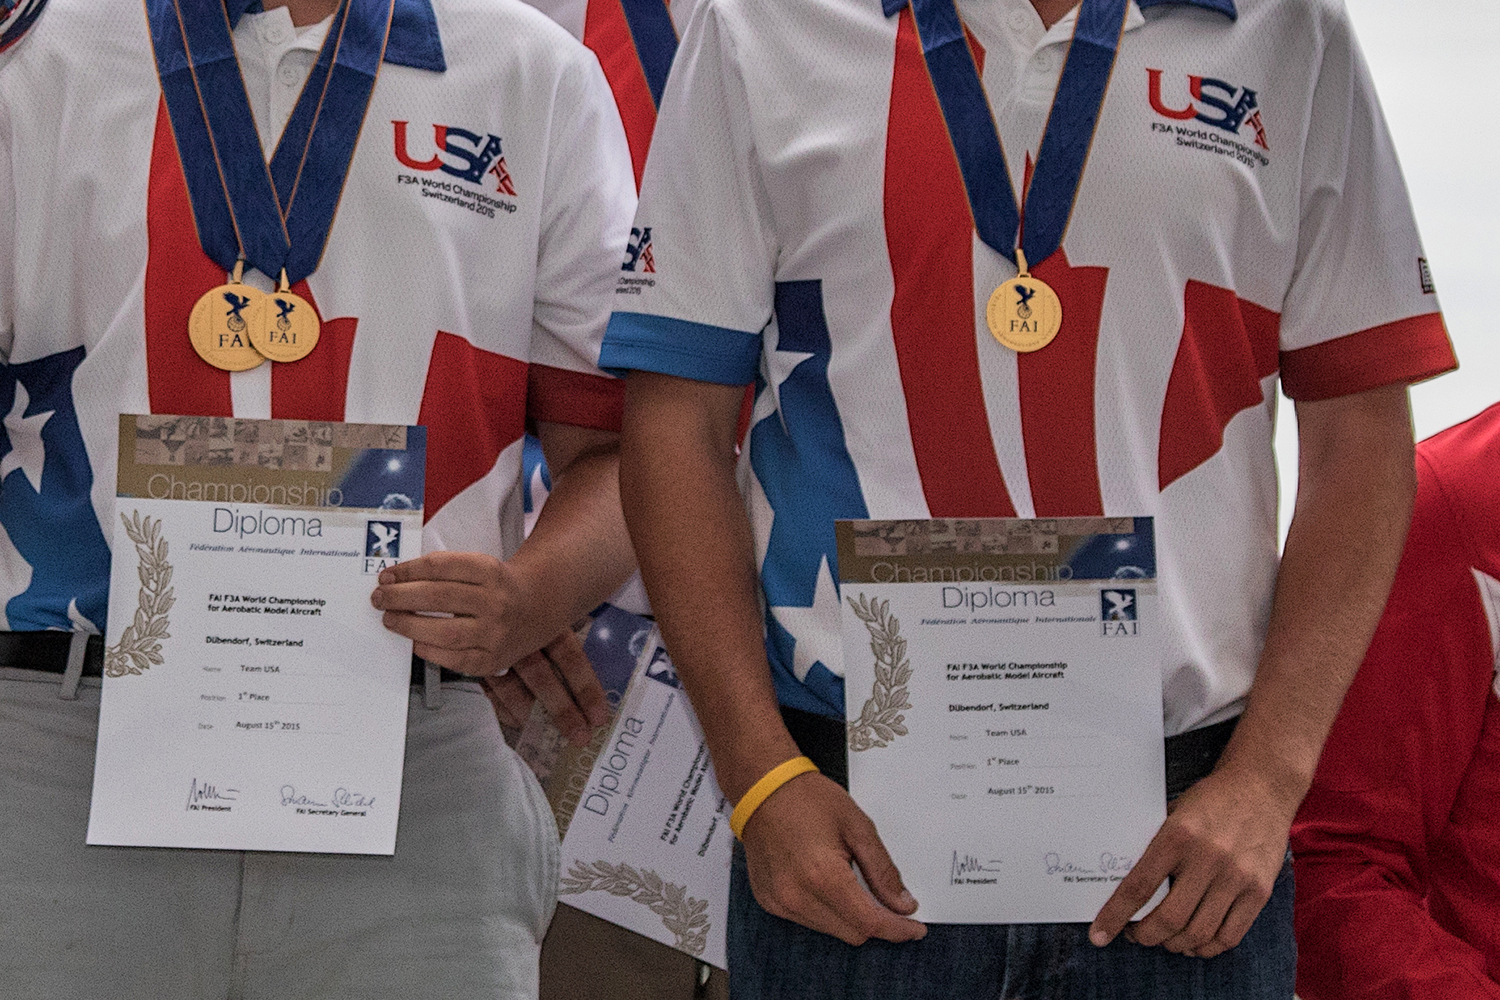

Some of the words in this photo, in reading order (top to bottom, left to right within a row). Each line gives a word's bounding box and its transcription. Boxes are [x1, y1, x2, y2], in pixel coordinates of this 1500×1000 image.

[1146, 68, 1270, 151] USA
[1152, 123, 1173, 133] F3A
[1176, 126, 1207, 139] World
[1209, 133, 1269, 166] Championship
[391, 121, 518, 197] USA
[1177, 137, 1235, 158] Switzerland
[1236, 151, 1254, 168] 2015
[398, 175, 419, 185] F3A
[422, 178, 451, 192] World
[453, 185, 517, 214] Championship
[422, 189, 475, 211] Switzerland
[476, 202, 495, 218] 2015
[1010, 320, 1037, 332] FAI
[270, 331, 296, 344] FAI
[147, 474, 344, 508] Championship
[213, 508, 322, 539] Diploma
[871, 561, 1074, 584] Championship
[209, 594, 222, 602] FAI
[224, 595, 240, 603] F3A
[268, 597, 326, 606] Championship
[942, 586, 1056, 612] Diploma
[208, 604, 220, 612] for
[222, 605, 261, 614] Aerobatic
[291, 608, 321, 616] Aircraft
[1103, 622, 1138, 635] FAI
[206, 636, 252, 646] Dübendorf,
[255, 638, 303, 647] Switzerland
[947, 663, 960, 671] FAI
[981, 662, 1006, 670] World
[1008, 662, 1068, 670] Championship
[947, 673, 959, 681] for
[1032, 671, 1064, 679] Aircraft
[250, 693, 270, 701] Place
[949, 703, 997, 712] Dübendorf,
[999, 702, 1049, 711] Switzerland
[236, 721, 262, 730] August
[281, 722, 300, 730] 2015
[986, 729, 1008, 737] Team
[583, 717, 645, 816] Diploma
[999, 758, 1019, 766] Place
[988, 787, 1015, 796] August
[1035, 786, 1054, 794] 2015
[673, 789, 687, 811] World
